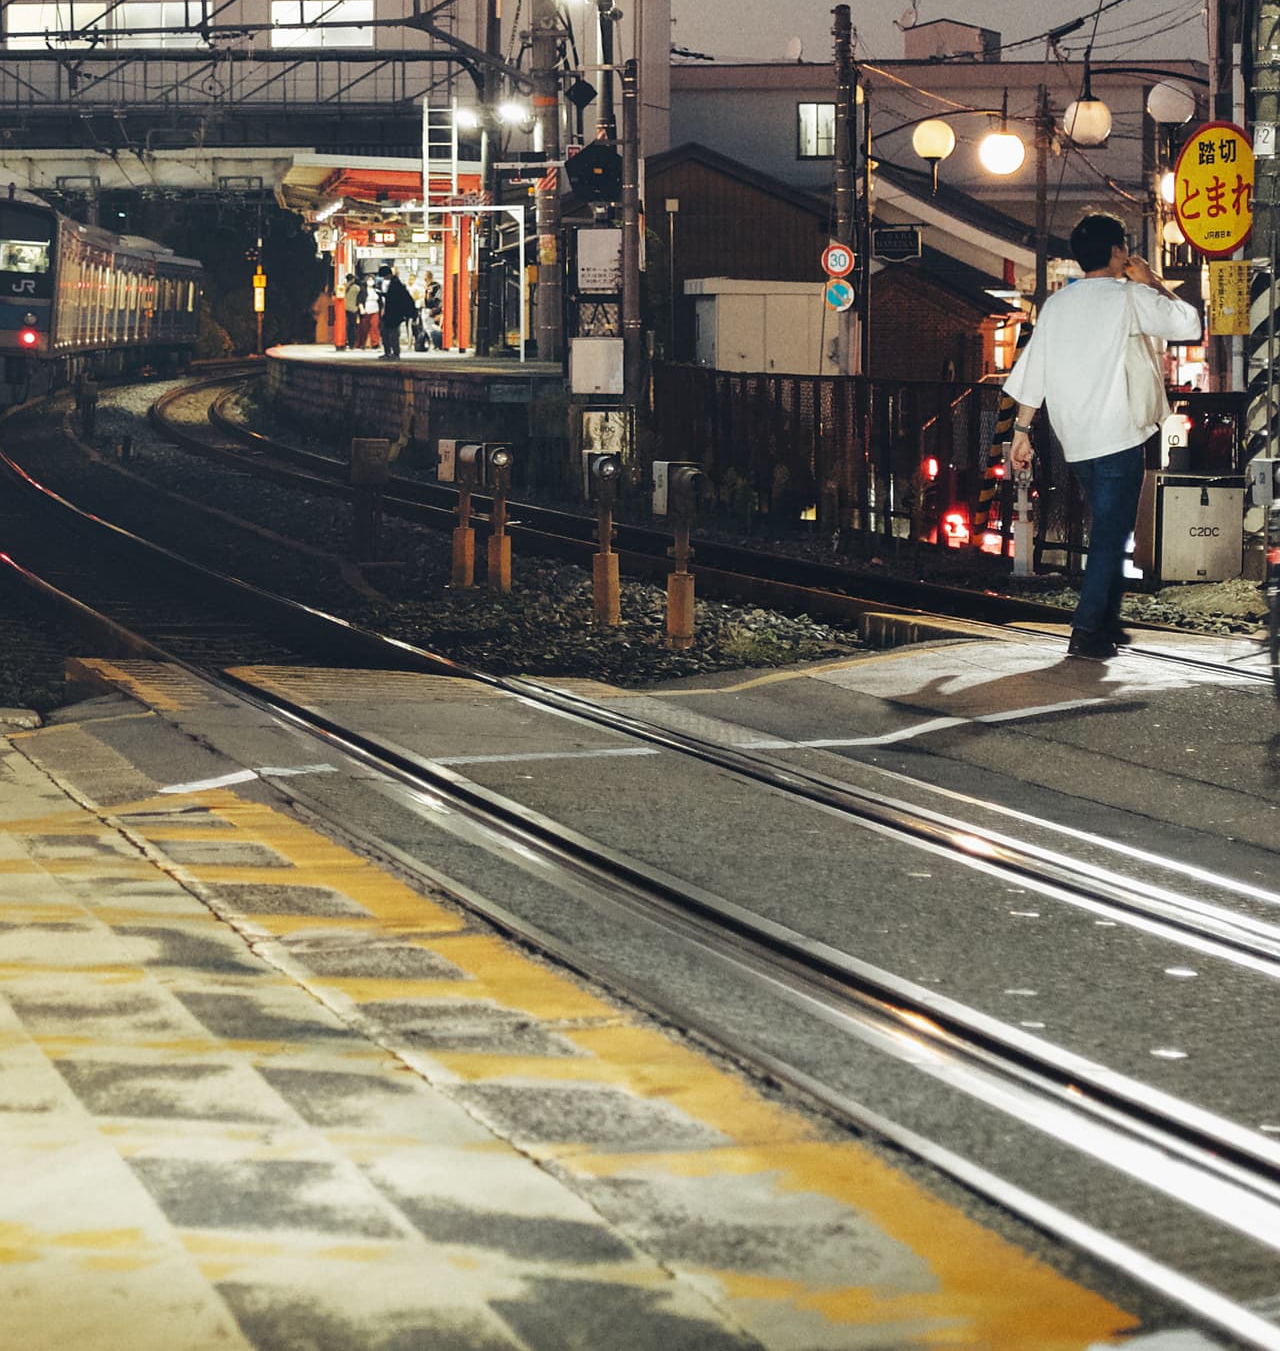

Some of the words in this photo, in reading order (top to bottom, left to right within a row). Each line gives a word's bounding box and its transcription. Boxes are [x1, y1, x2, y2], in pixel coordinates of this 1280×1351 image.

[1198, 139, 1237, 165] 踏切
[1180, 174, 1253, 220] とまれ
[1204, 230, 1232, 240] JR西日本
[830, 253, 847, 268] 30
[12, 280, 36, 293] JR
[1189, 526, 1220, 537] C2DC
